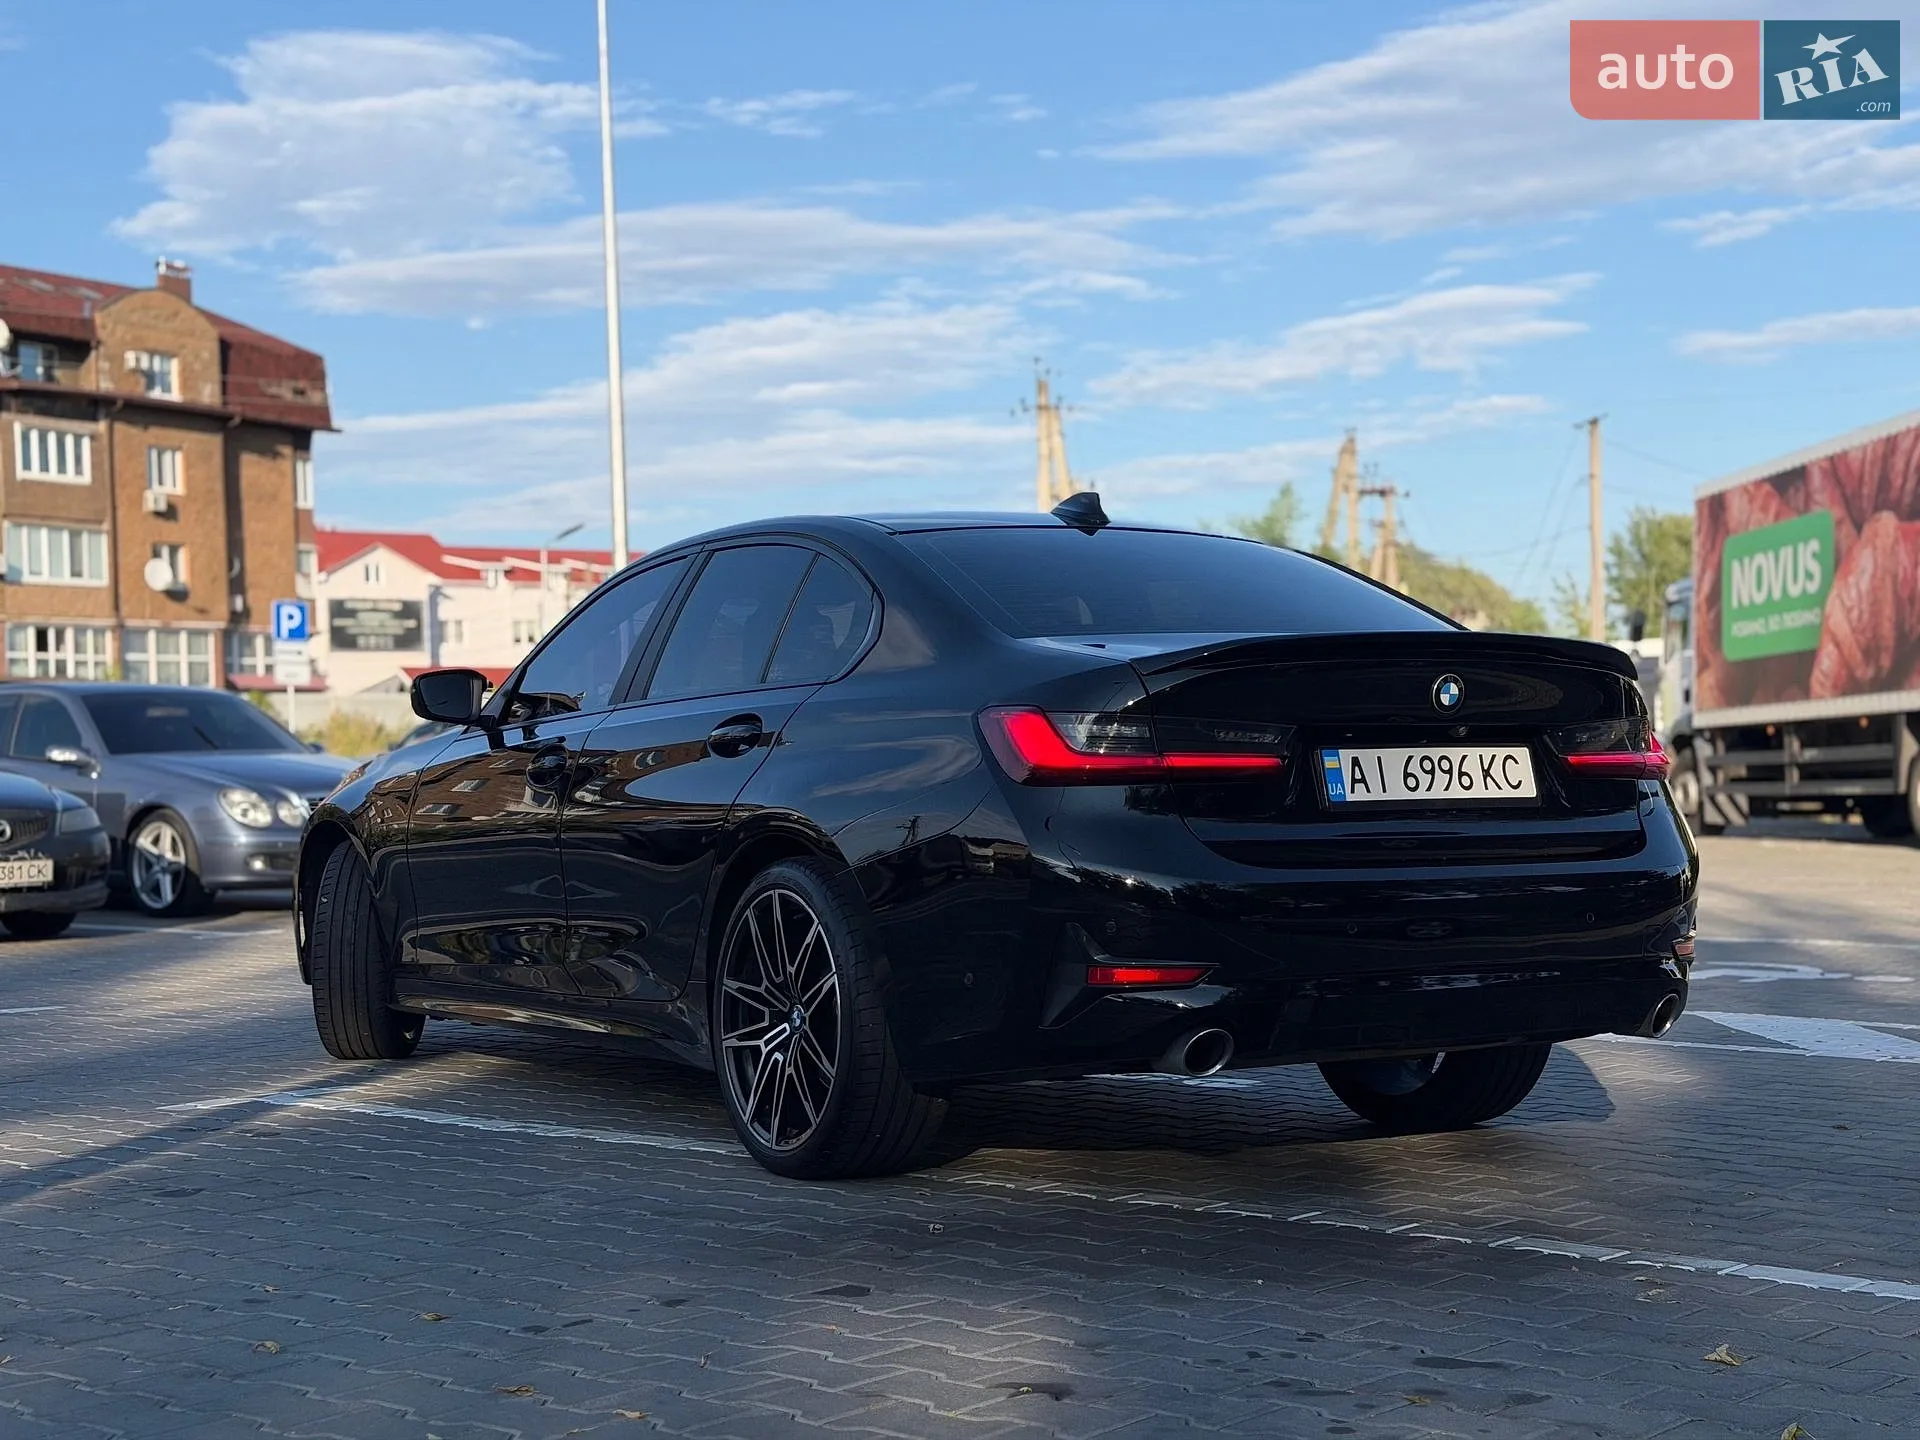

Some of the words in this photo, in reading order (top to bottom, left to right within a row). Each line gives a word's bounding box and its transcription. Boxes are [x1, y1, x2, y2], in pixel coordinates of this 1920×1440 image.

[1731, 537, 1822, 609] NOVUS
[279, 604, 303, 639] P
[1328, 783, 1345, 796] UA
